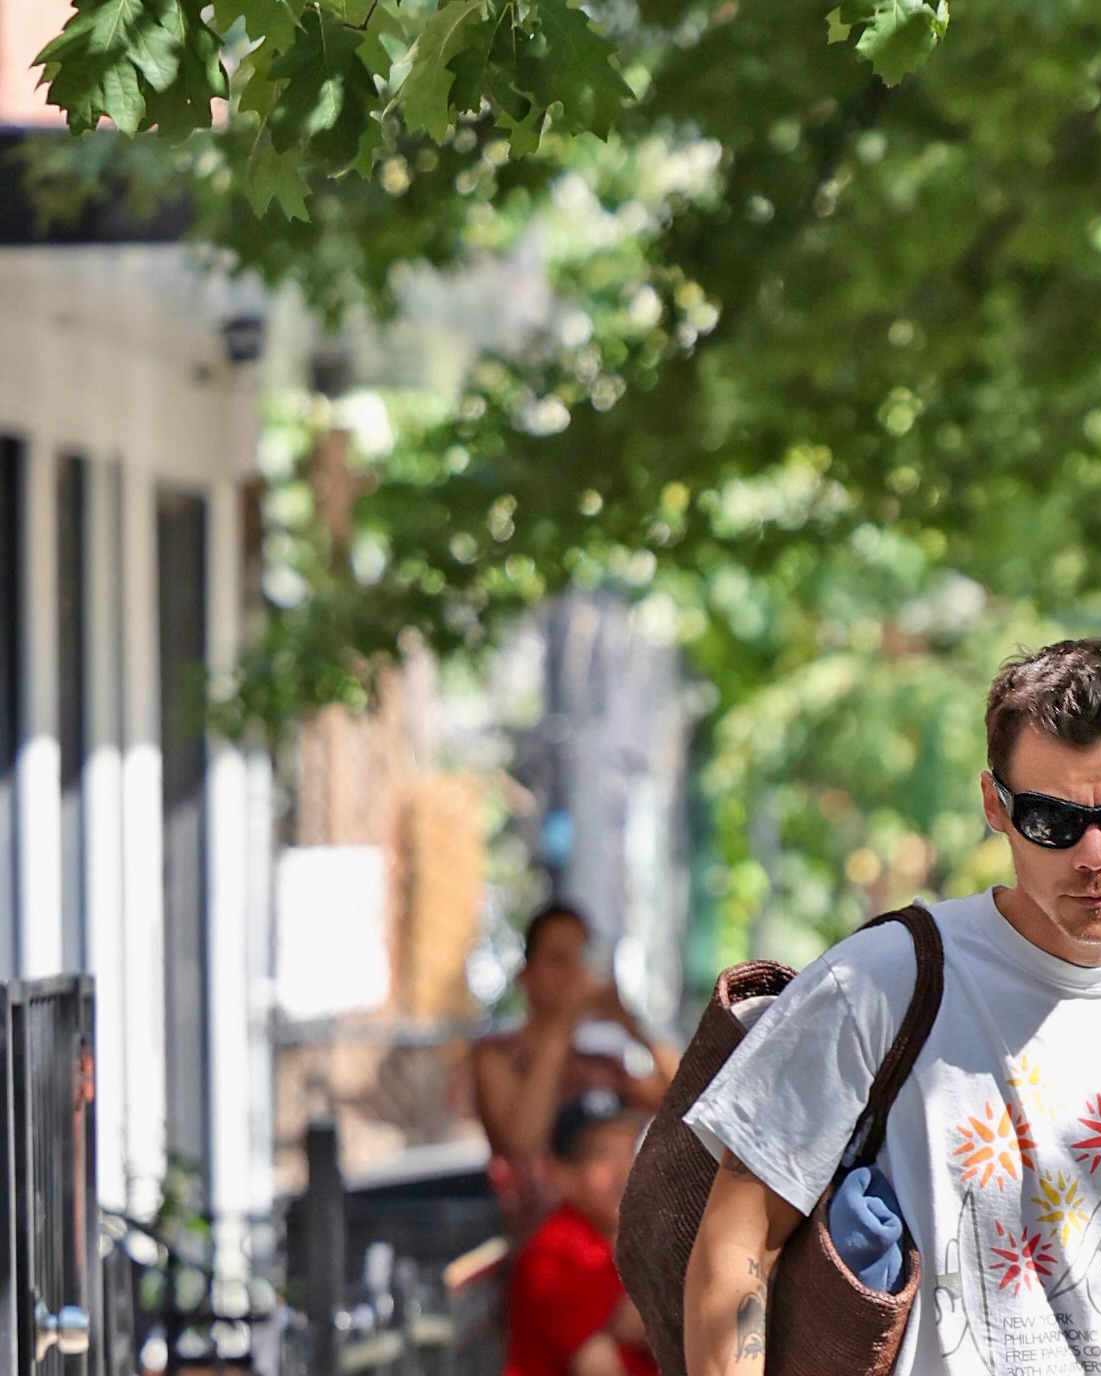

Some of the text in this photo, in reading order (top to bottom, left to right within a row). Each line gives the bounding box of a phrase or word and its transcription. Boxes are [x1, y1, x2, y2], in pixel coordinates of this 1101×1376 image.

[1003, 1312, 1074, 1329] NEW YORK
[1004, 1328, 1099, 1346] PHILHARMONIC
[1005, 1349, 1038, 1362] FREE
[1041, 1344, 1081, 1359] PARKS
